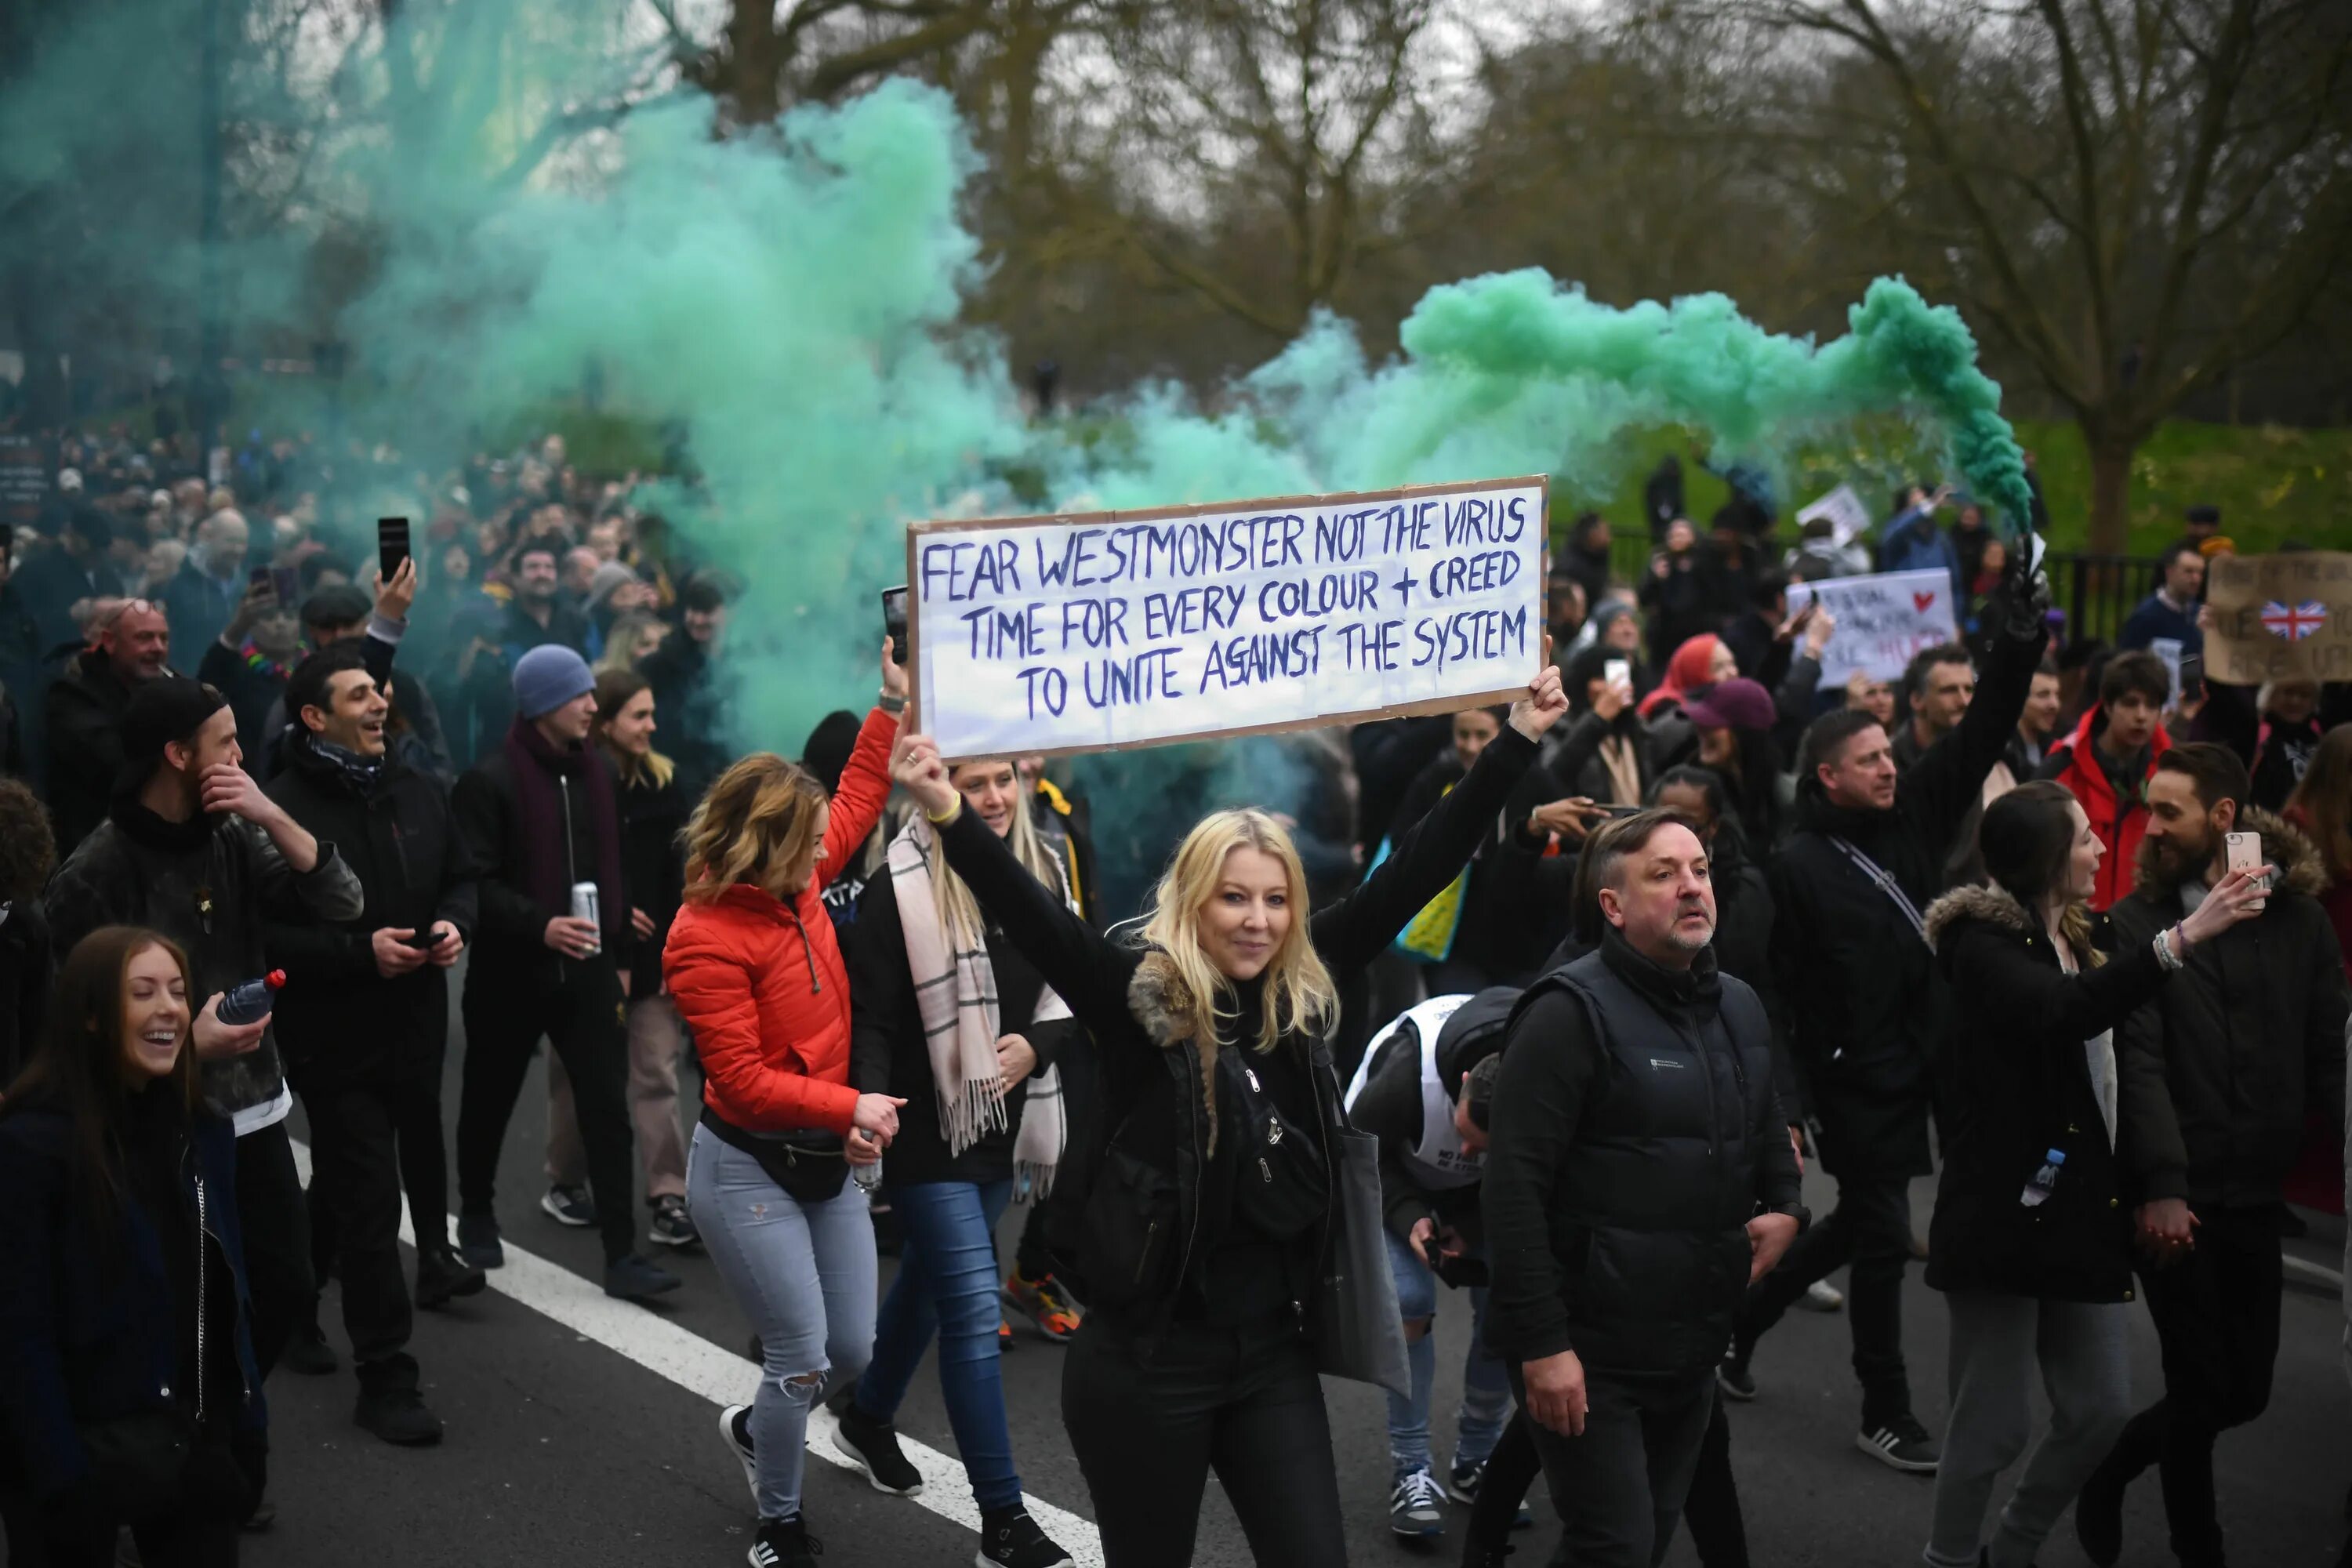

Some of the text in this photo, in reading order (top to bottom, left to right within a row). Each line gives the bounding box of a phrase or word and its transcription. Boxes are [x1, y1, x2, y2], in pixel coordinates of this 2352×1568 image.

[922, 496, 1526, 603] FEAR WESTMONSTER NOT THE VIRUS
[960, 550, 1521, 659] TIME FOR EVERY COLOUR + CREED
[1017, 604, 1526, 721] TO UNITE AGAINST THE SYSTEM
